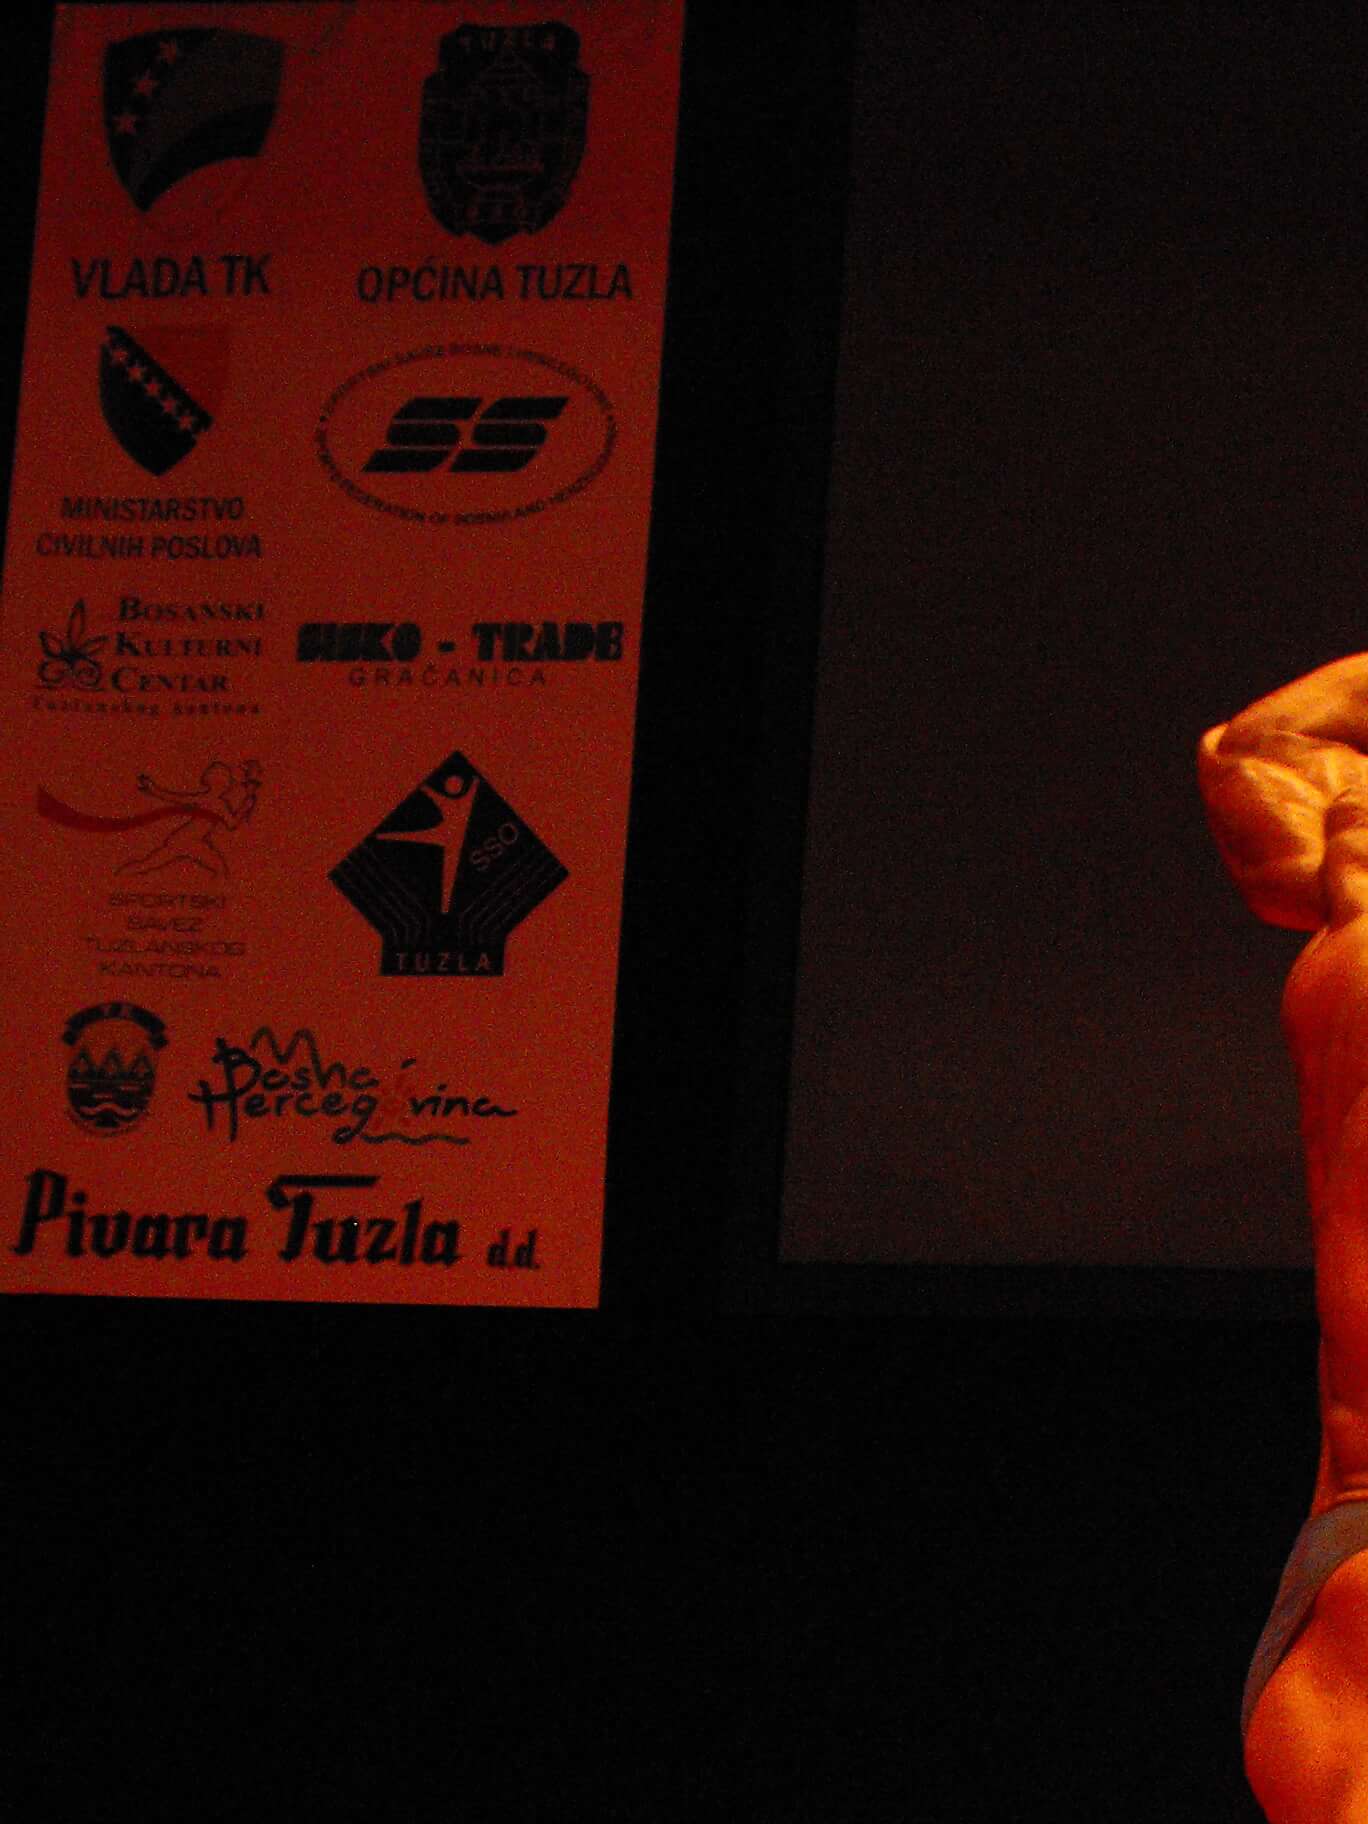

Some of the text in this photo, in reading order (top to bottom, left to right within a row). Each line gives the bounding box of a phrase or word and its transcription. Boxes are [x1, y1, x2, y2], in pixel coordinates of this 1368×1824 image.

[71, 254, 272, 300] VLADA TK
[356, 256, 635, 301] OPĆINA TUZLA
[60, 495, 245, 521] MINISTARSTVO
[34, 531, 264, 561] CIVILNIH POSLOVA
[471, 621, 625, 663] TRADE
[348, 661, 547, 688] GRAČANICA
[395, 952, 492, 973] TUZLA
[10, 1168, 248, 1263] Pivara
[265, 1173, 461, 1267] Tuzla
